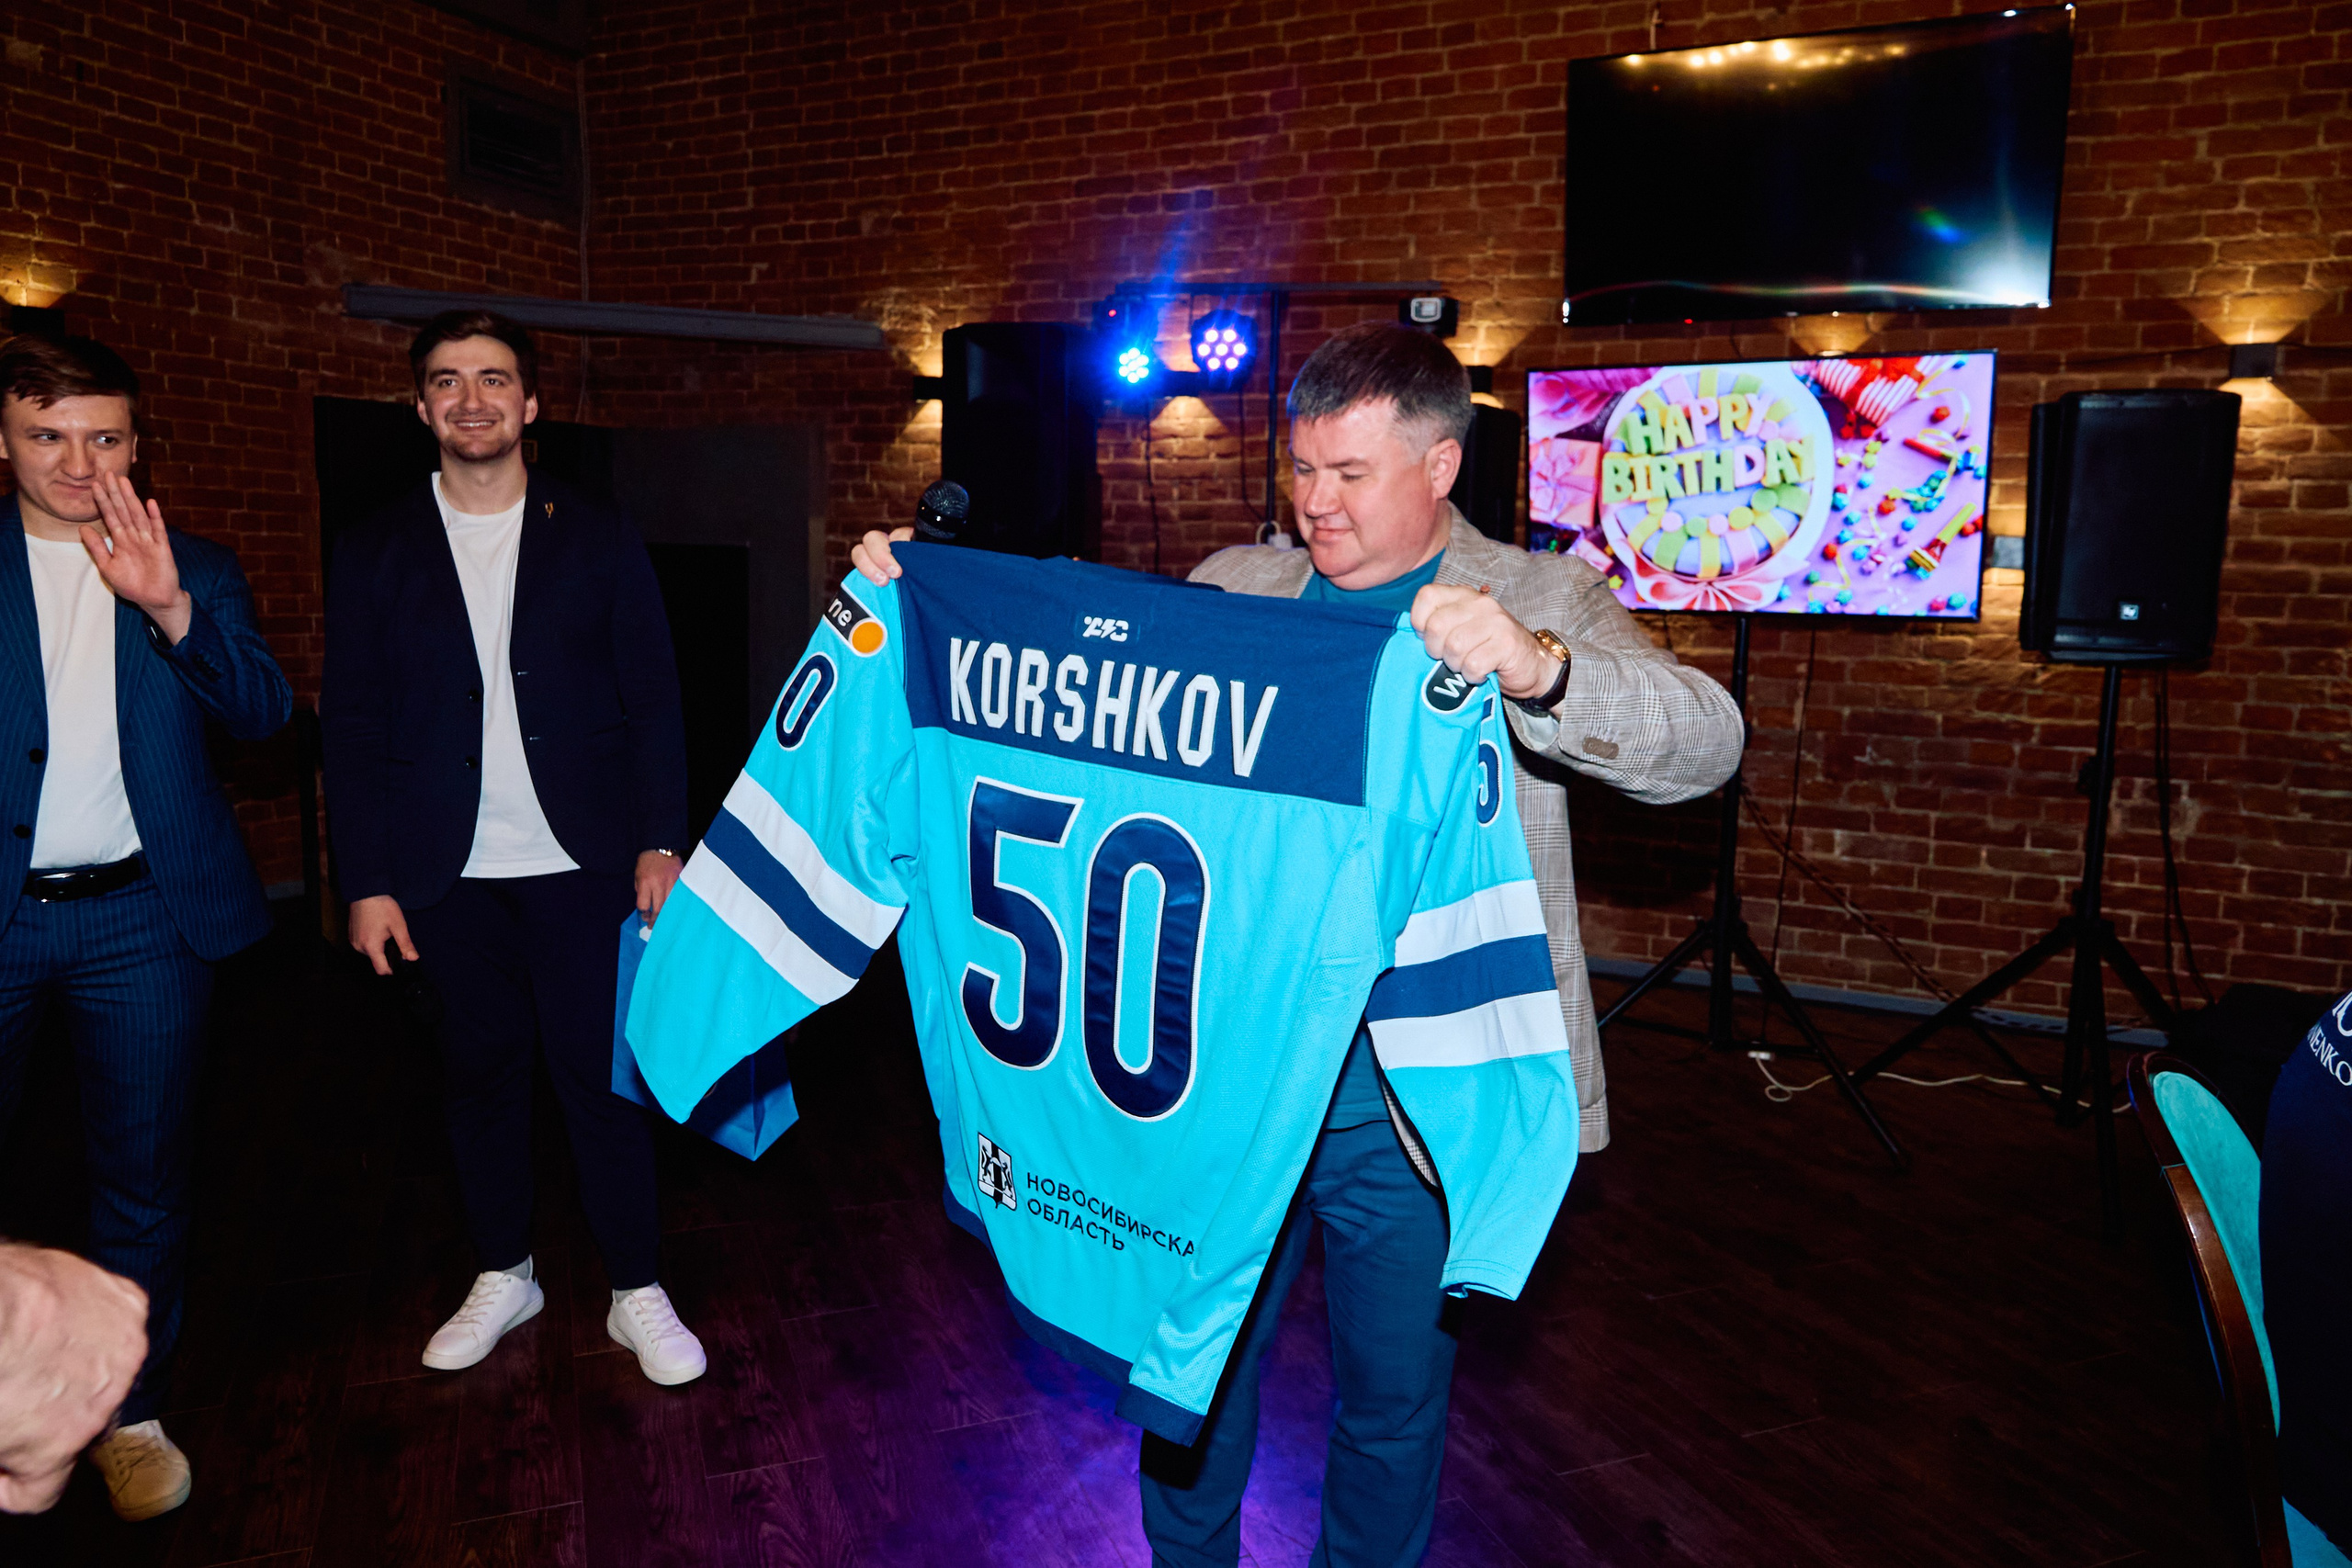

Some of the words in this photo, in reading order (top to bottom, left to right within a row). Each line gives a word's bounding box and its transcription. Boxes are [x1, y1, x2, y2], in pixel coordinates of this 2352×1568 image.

[1625, 393, 1769, 455] HAPPY
[1602, 436, 1816, 503] BIRTHDAY
[949, 637, 1278, 777] KORSHKOV
[962, 776, 1211, 1122] 50
[1026, 1198, 1125, 1251] ОБЛАСТЬ
